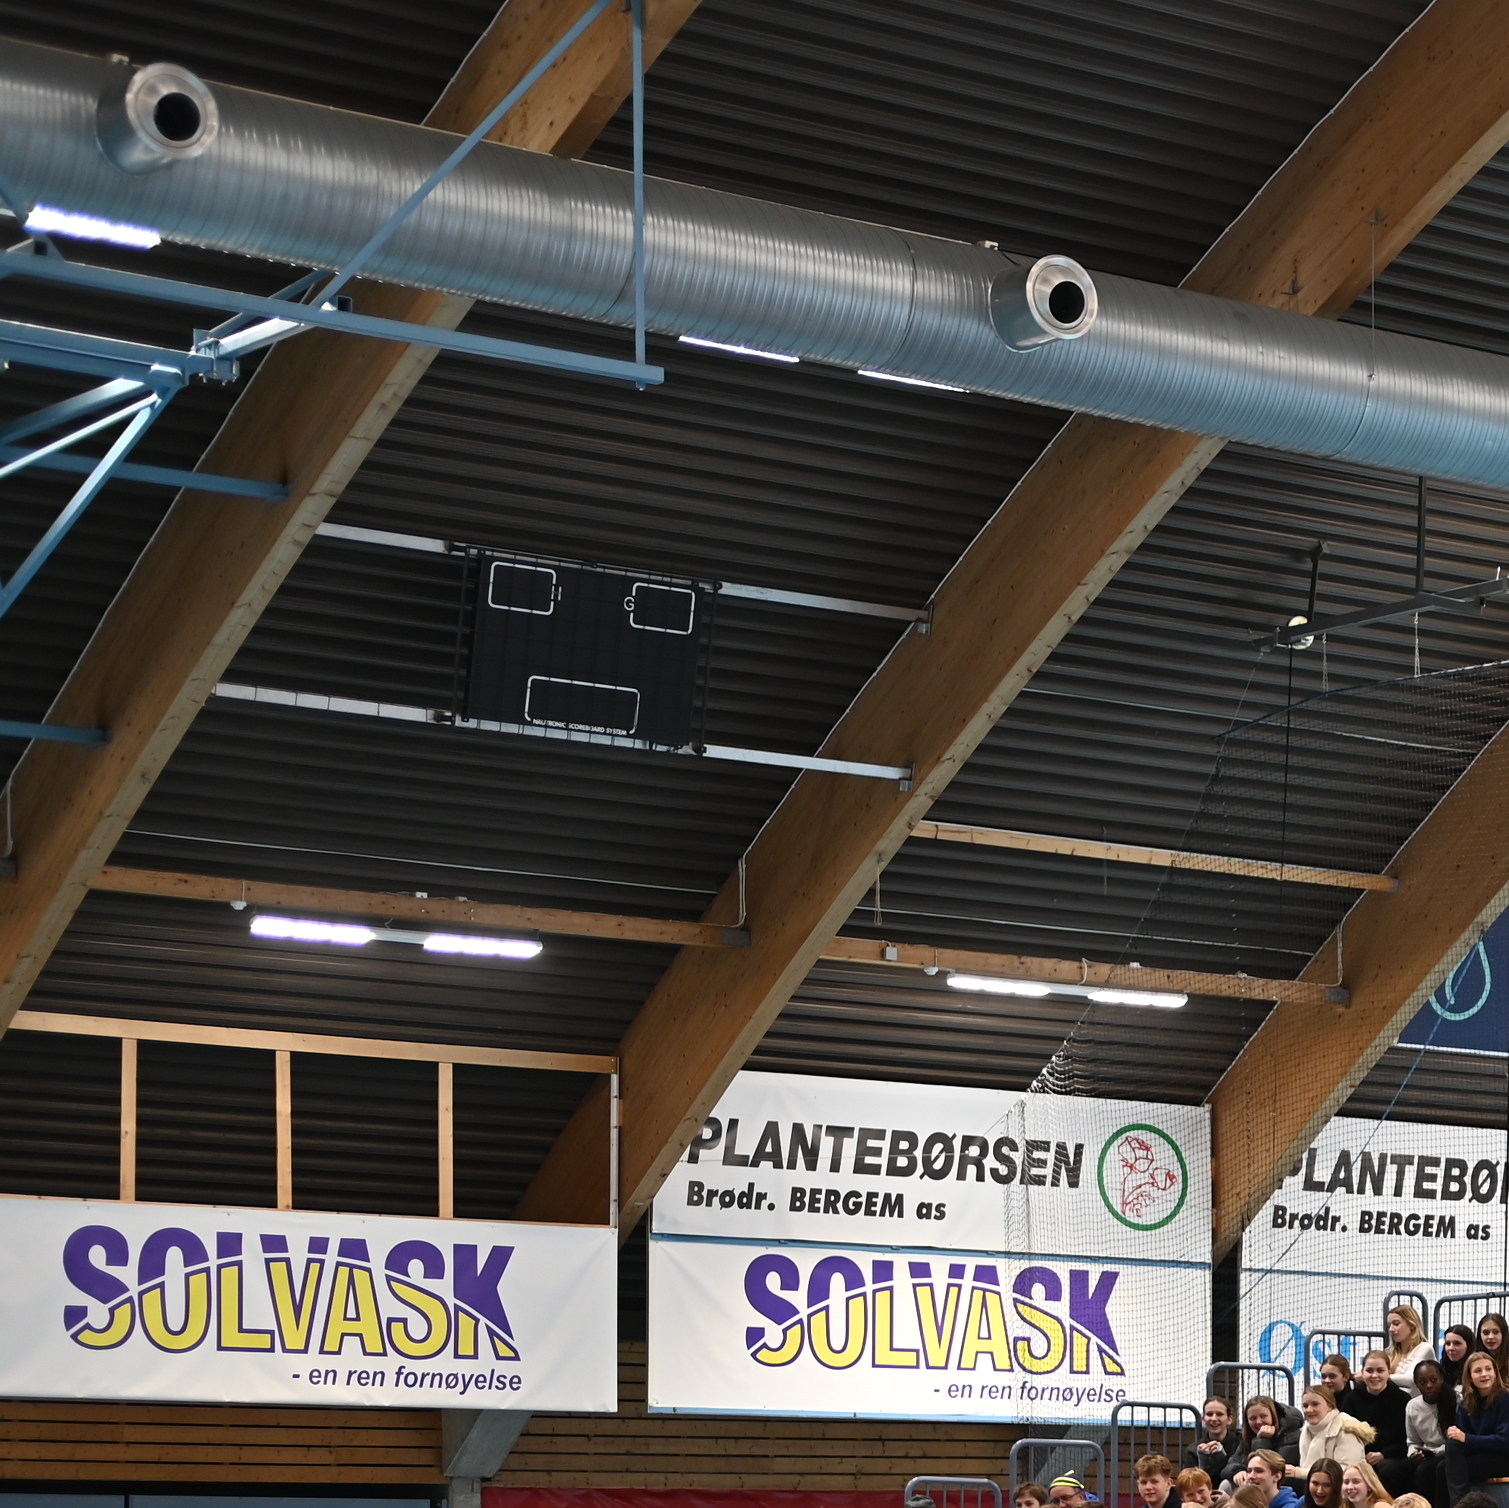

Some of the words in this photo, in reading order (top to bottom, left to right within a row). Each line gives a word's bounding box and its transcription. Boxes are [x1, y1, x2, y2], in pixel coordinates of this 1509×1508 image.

[686, 1116, 1085, 1189] PLANTEBØRSEN
[686, 1180, 777, 1212] Brødr.
[788, 1187, 905, 1219] BERGEM
[915, 1201, 947, 1221] as
[1271, 1204, 1348, 1233] Brødr.
[1358, 1210, 1457, 1239] BERGEM
[1465, 1223, 1492, 1242] as
[63, 1225, 521, 1362] SOLVASK
[743, 1253, 1126, 1377] SOLVASK
[308, 1369, 338, 1387] en
[345, 1369, 386, 1389] ren
[393, 1364, 523, 1395] fornøyelse
[947, 1384, 972, 1399] en
[979, 1385, 1012, 1401] ren
[1019, 1380, 1127, 1405] fornøyelse
